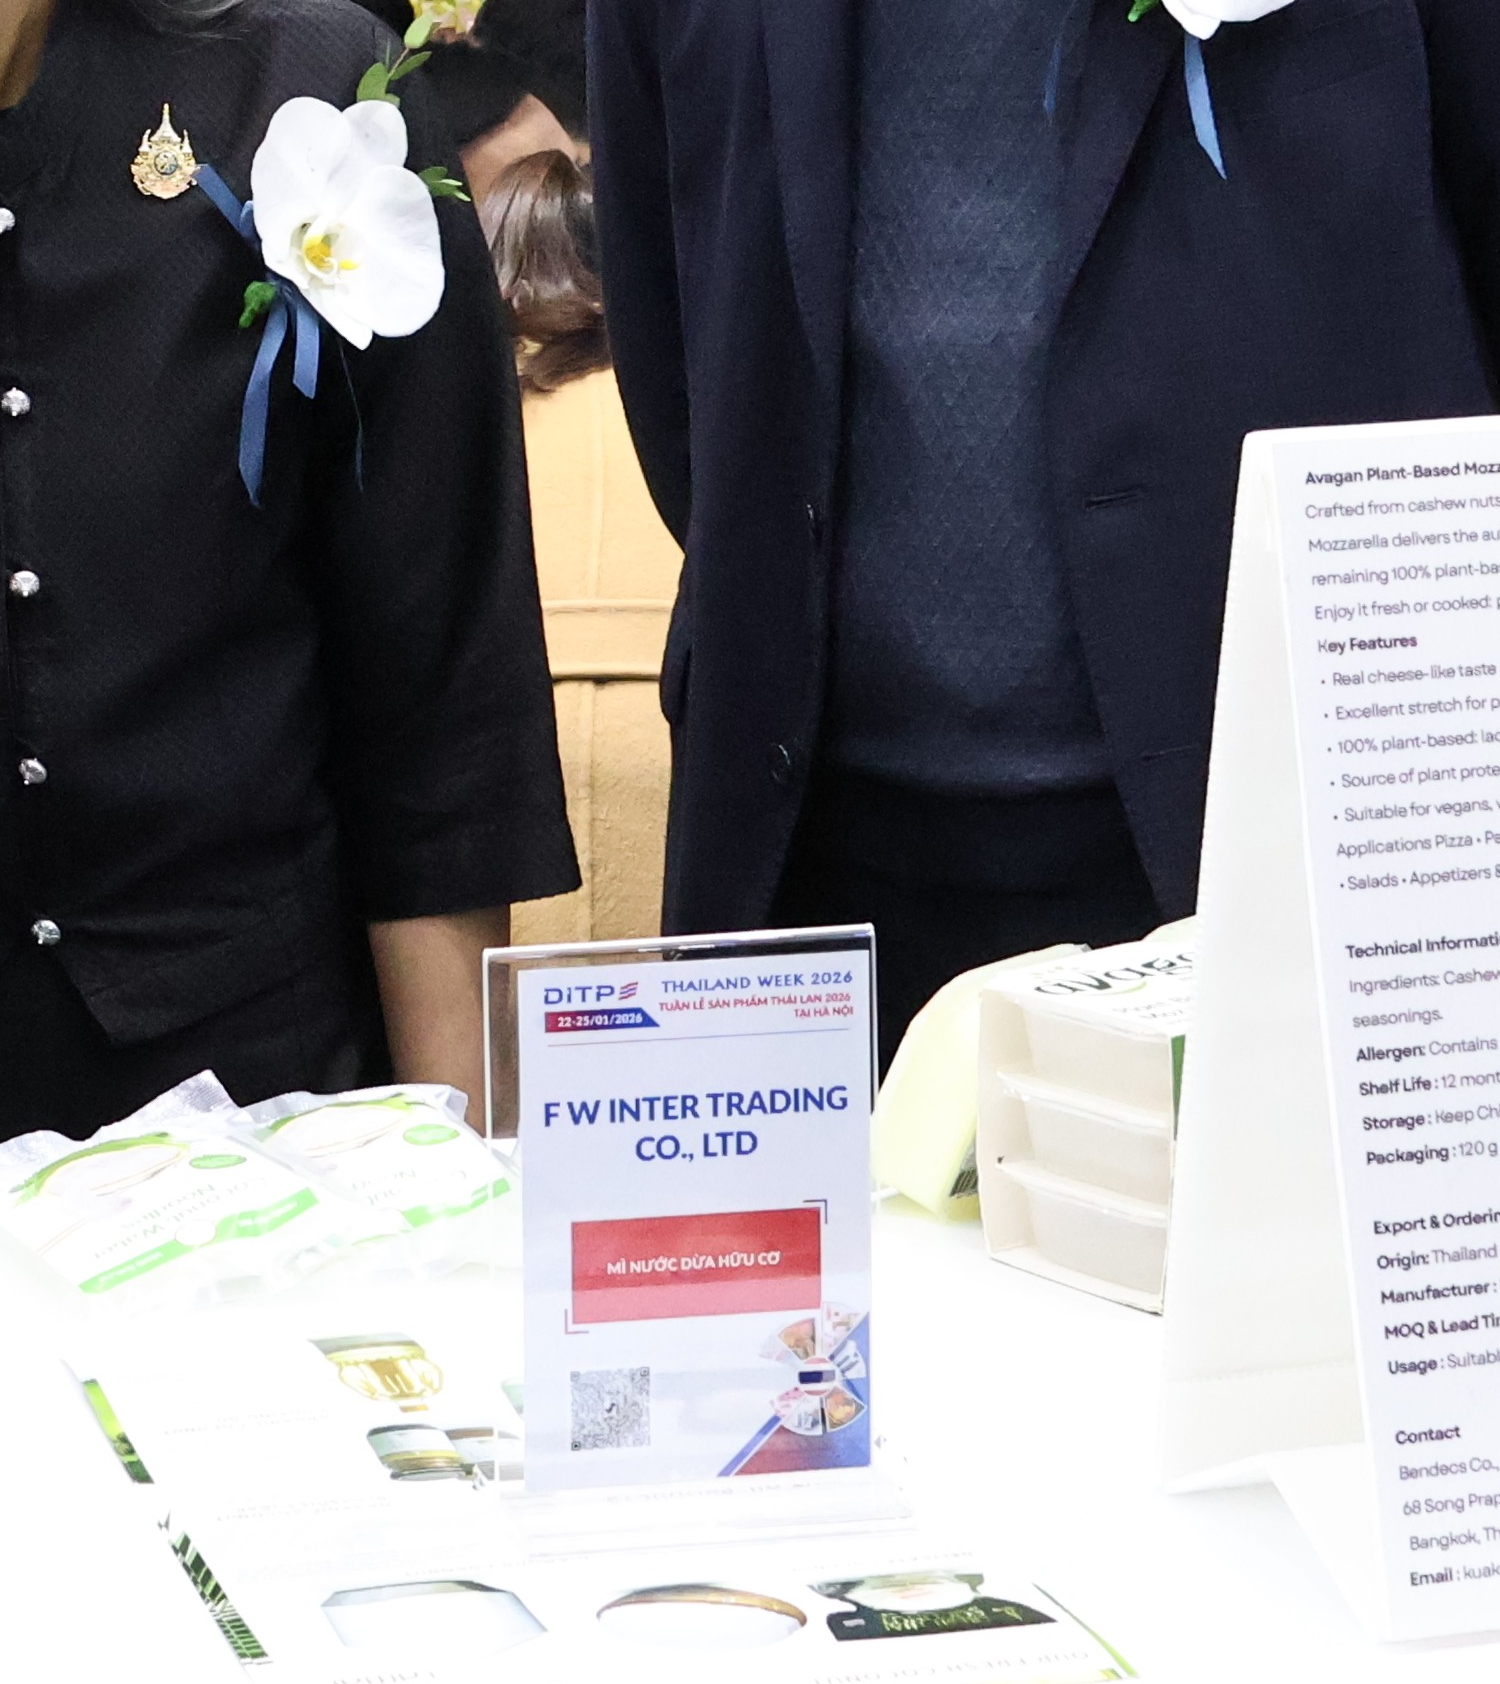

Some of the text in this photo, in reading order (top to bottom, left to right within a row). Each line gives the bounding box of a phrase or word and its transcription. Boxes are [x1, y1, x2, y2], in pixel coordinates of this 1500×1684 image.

[1304, 469, 1364, 488] Avagan
[1365, 462, 1461, 481] Plant-Based
[1316, 633, 1418, 657] Key Features
[1334, 702, 1405, 720] Excellent
[1407, 697, 1463, 714] stretch
[1464, 694, 1488, 711] for
[1344, 938, 1423, 959] Technical
[544, 971, 853, 1005] DITP THAILAND WEEK 2026
[801, 994, 822, 1004] LAN
[825, 993, 851, 1003] 2026
[557, 1013, 642, 1028] 22-25/01/2026
[1354, 1042, 1427, 1065] Allergen:
[1428, 1036, 1498, 1055] Contains
[544, 1086, 848, 1127] F W INTER TRADING
[636, 1131, 758, 1161] CO., LTD
[1372, 1216, 1427, 1237] Export
[607, 1251, 780, 1275] MÌ NƯỚC DỪA HỮU CƠ
[1394, 1424, 1461, 1445] Contact
[1409, 1529, 1481, 1553] Bangkok,
